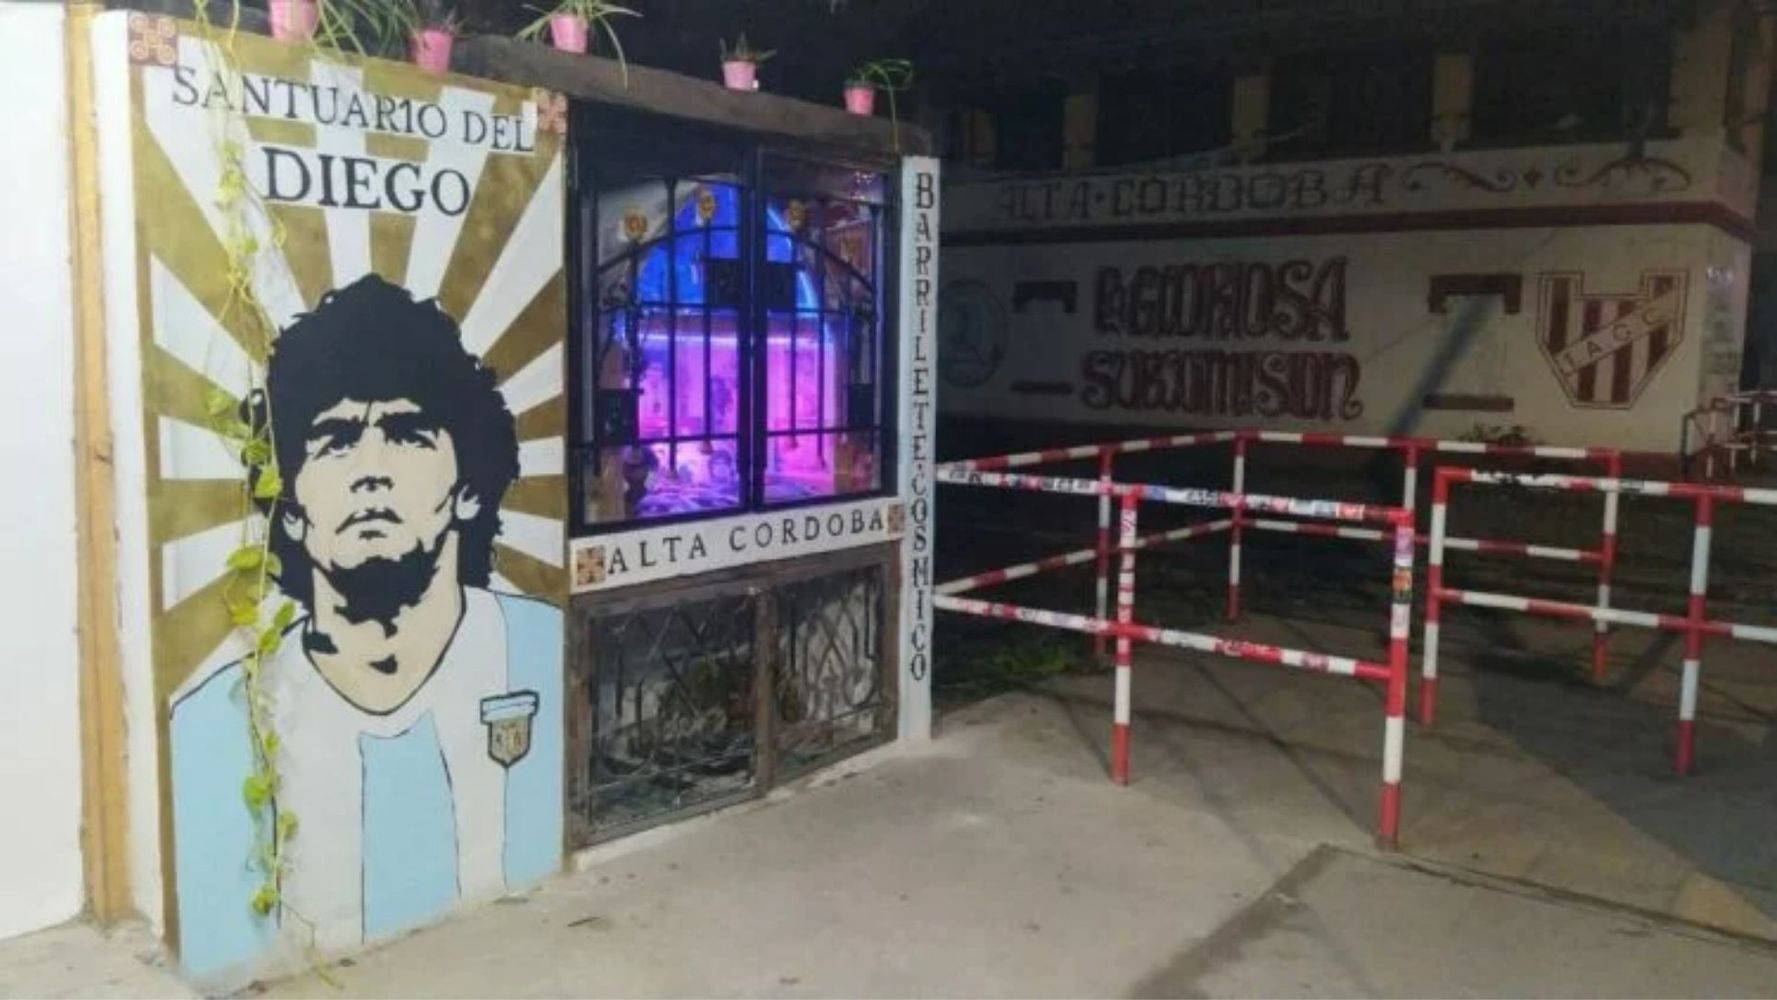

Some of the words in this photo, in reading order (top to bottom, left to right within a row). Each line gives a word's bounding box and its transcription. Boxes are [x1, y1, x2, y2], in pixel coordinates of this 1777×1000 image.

[462, 110, 535, 152] DEL
[263, 147, 471, 217] DIEGO
[607, 535, 707, 574] ALTA
[729, 509, 883, 551] CORDOBA
